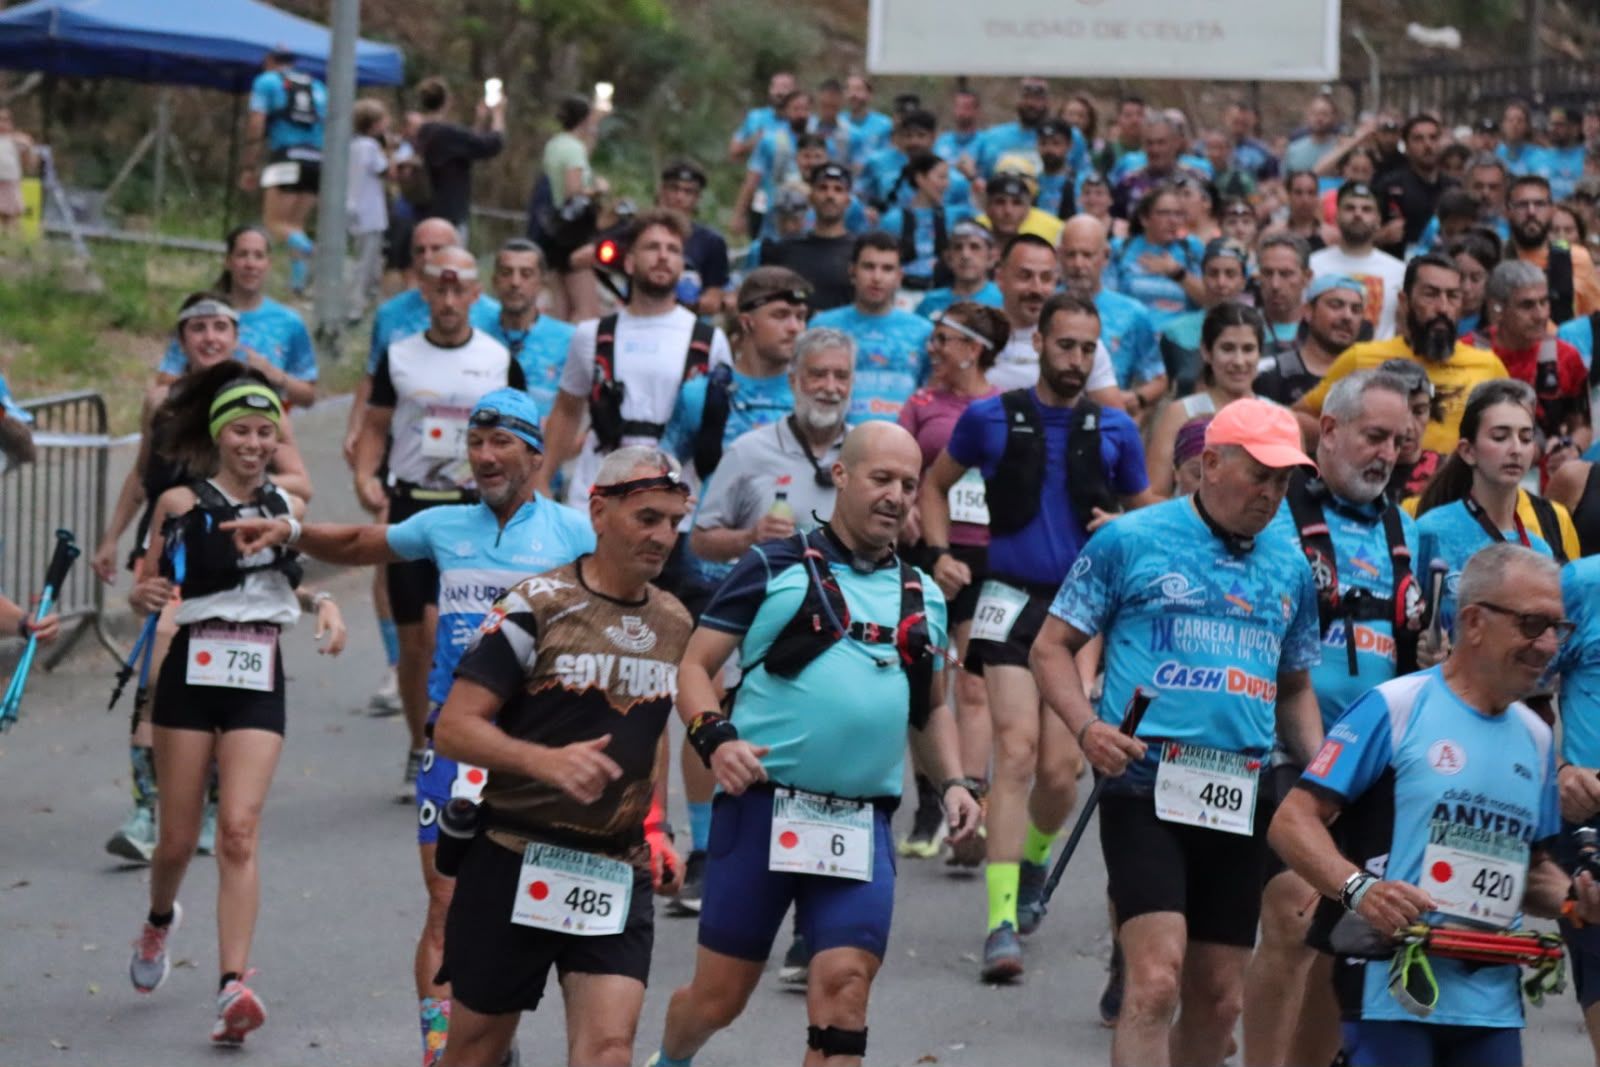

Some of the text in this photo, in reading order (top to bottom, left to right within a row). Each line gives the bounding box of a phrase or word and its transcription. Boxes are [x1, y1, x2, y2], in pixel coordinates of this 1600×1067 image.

[983, 18, 1225, 42] CIUDAD DE CEUTA
[1173, 617, 1235, 644] CARRERA
[226, 649, 262, 673] 736
[554, 652, 615, 689] SOY
[1153, 660, 1224, 692] CASH
[1199, 782, 1243, 812] 489
[830, 833, 845, 857] 6
[1472, 868, 1515, 902] 420
[564, 886, 613, 918] 485
